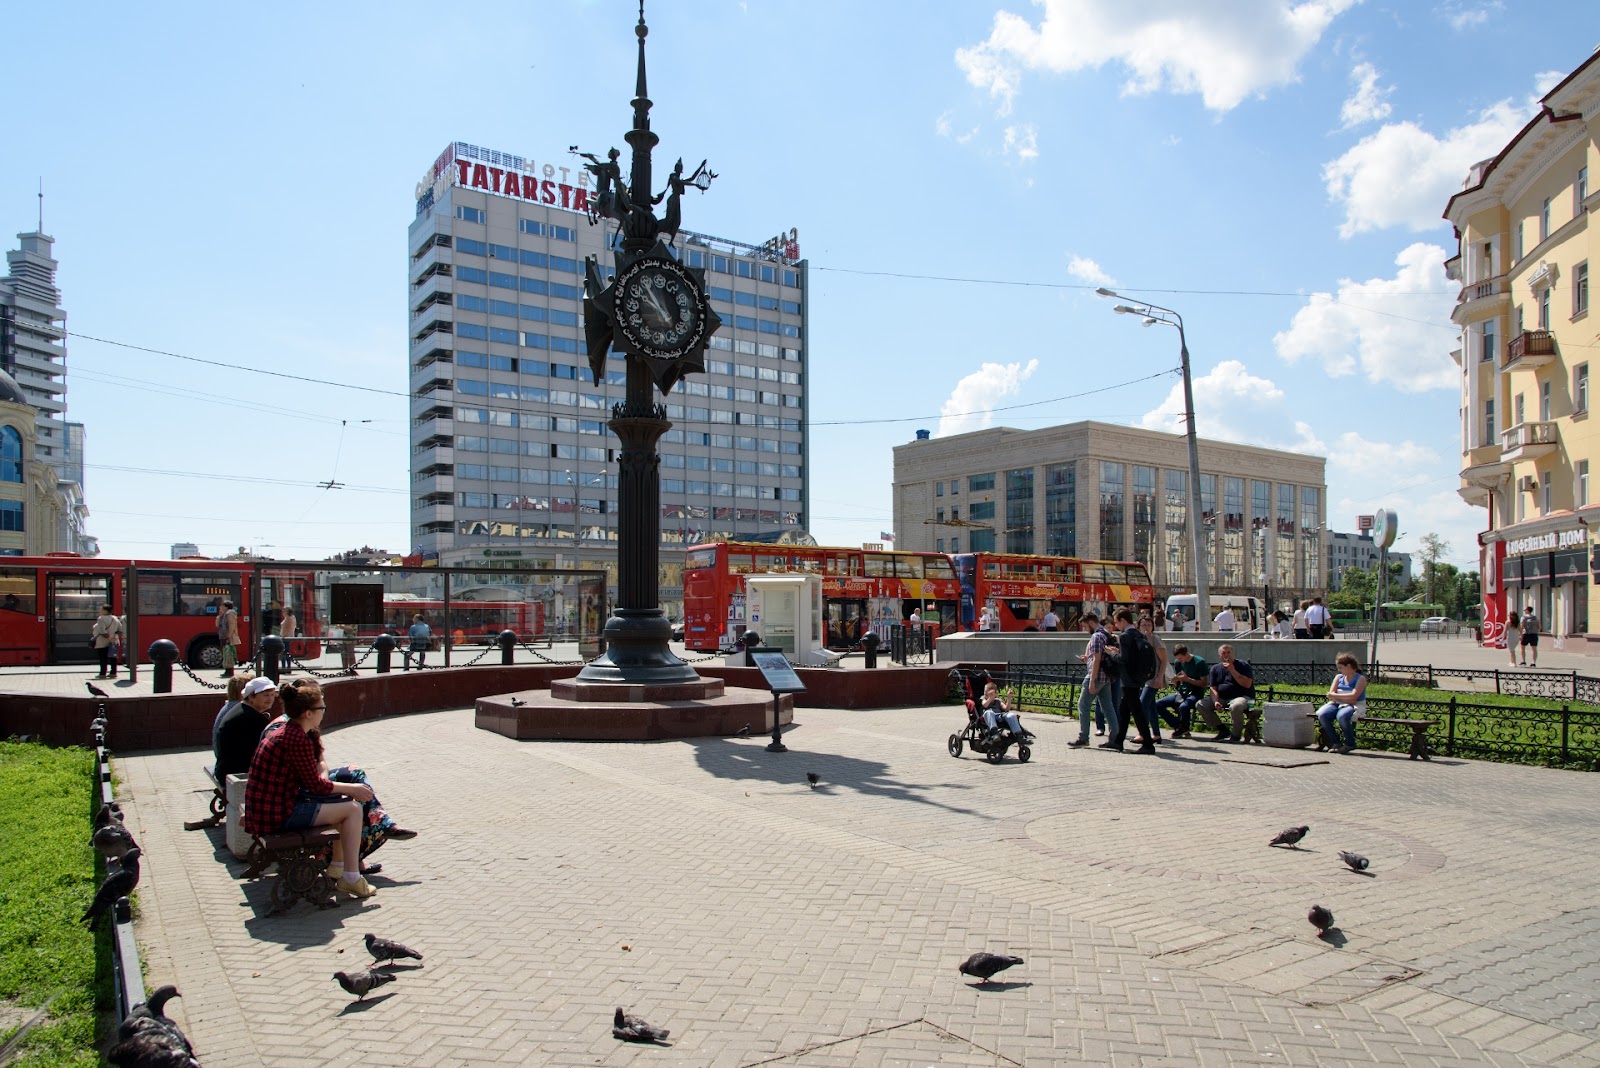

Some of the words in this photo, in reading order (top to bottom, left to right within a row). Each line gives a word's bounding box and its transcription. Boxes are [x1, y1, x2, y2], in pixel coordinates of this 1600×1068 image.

[523, 158, 588, 186] HOTE
[455, 159, 599, 217] TATARSTA
[1510, 532, 1556, 555] КОФЕЙНЫЙ
[1558, 529, 1585, 549] ДОМ
